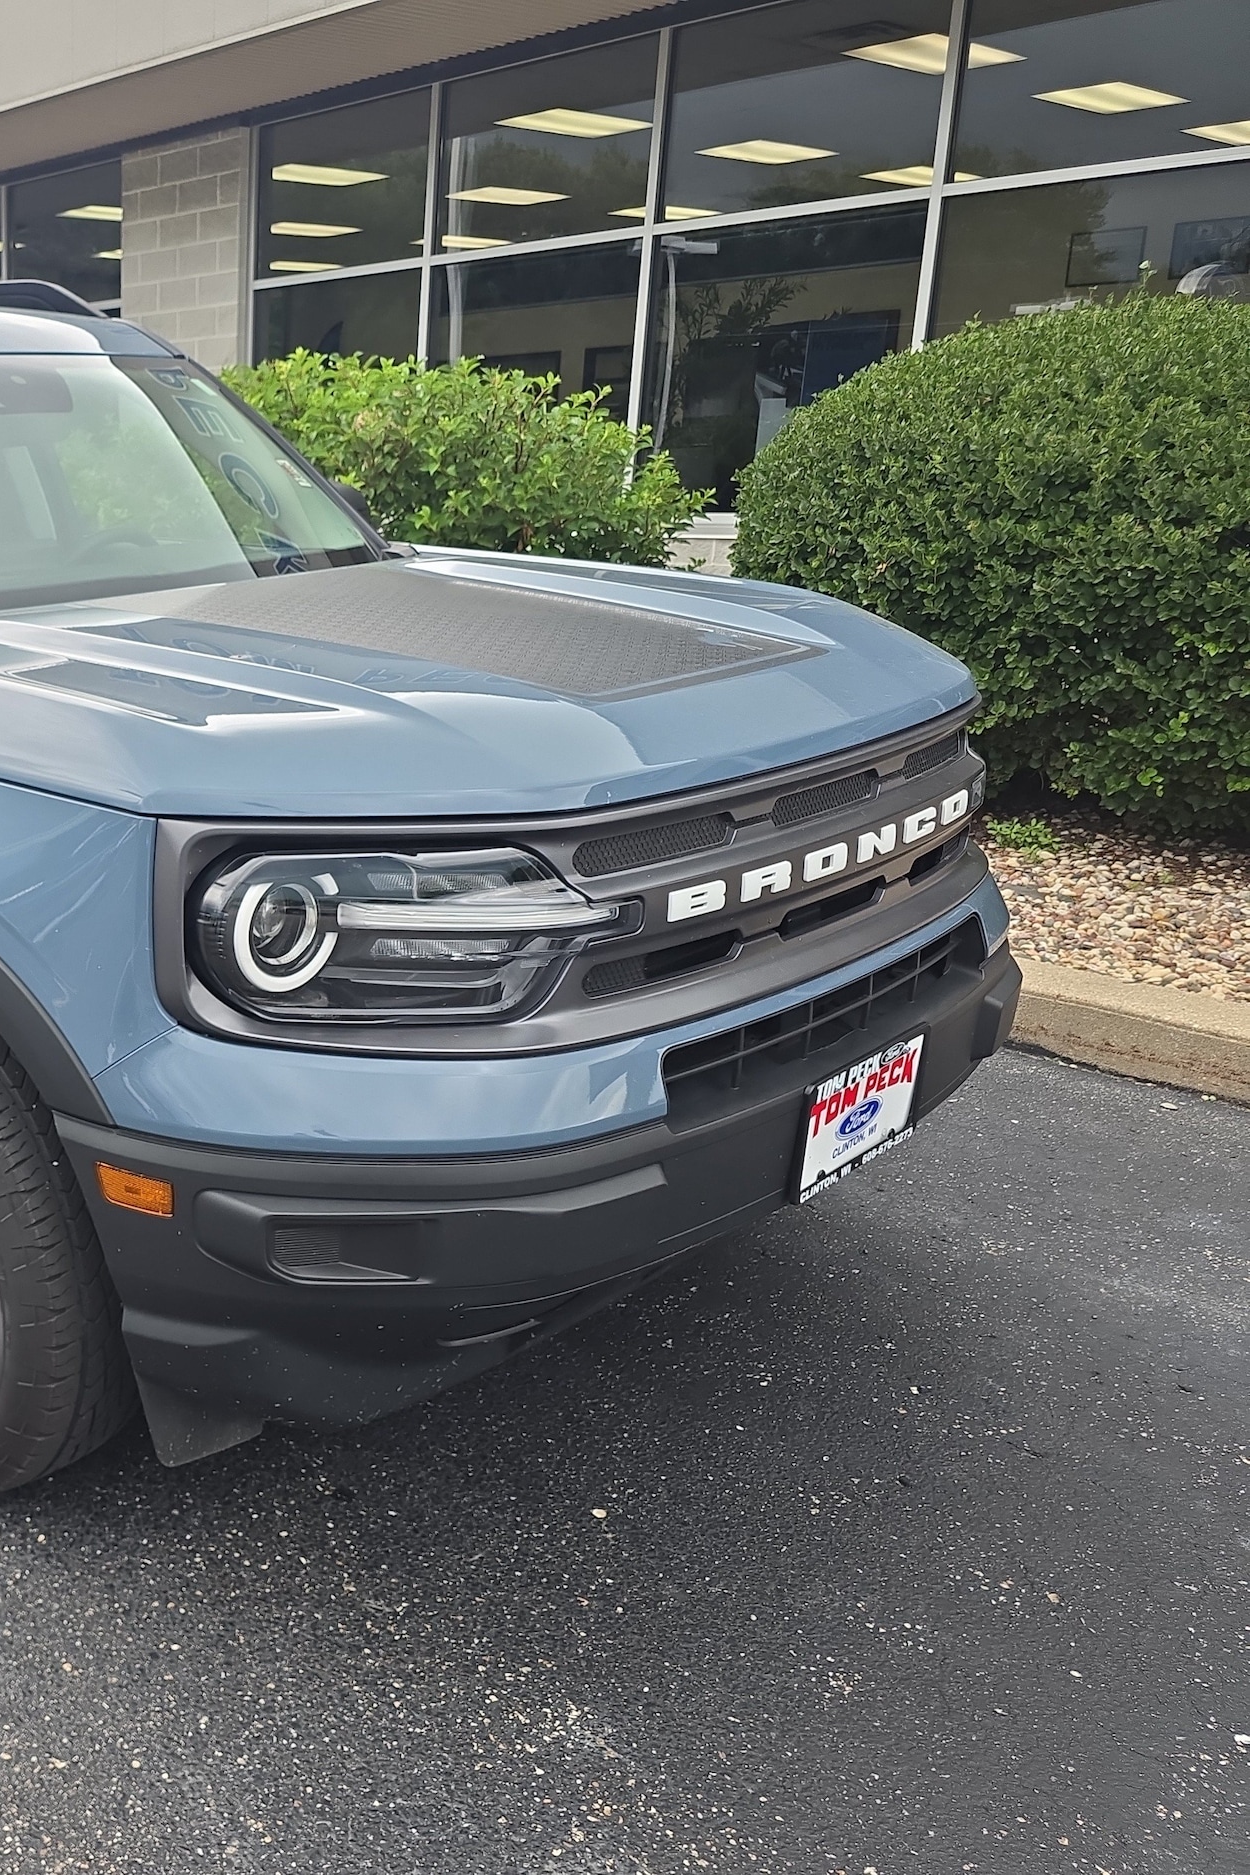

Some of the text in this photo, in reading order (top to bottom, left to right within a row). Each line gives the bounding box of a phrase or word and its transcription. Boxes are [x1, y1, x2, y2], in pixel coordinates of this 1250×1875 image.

[667, 788, 969, 923] BRONCO
[847, 1052, 883, 1086] PECK
[810, 1048, 918, 1139] TOM PECK
[844, 1104, 875, 1133] Ford
[831, 1122, 878, 1160] CLINTON, WI
[841, 1163, 852, 1180] WI
